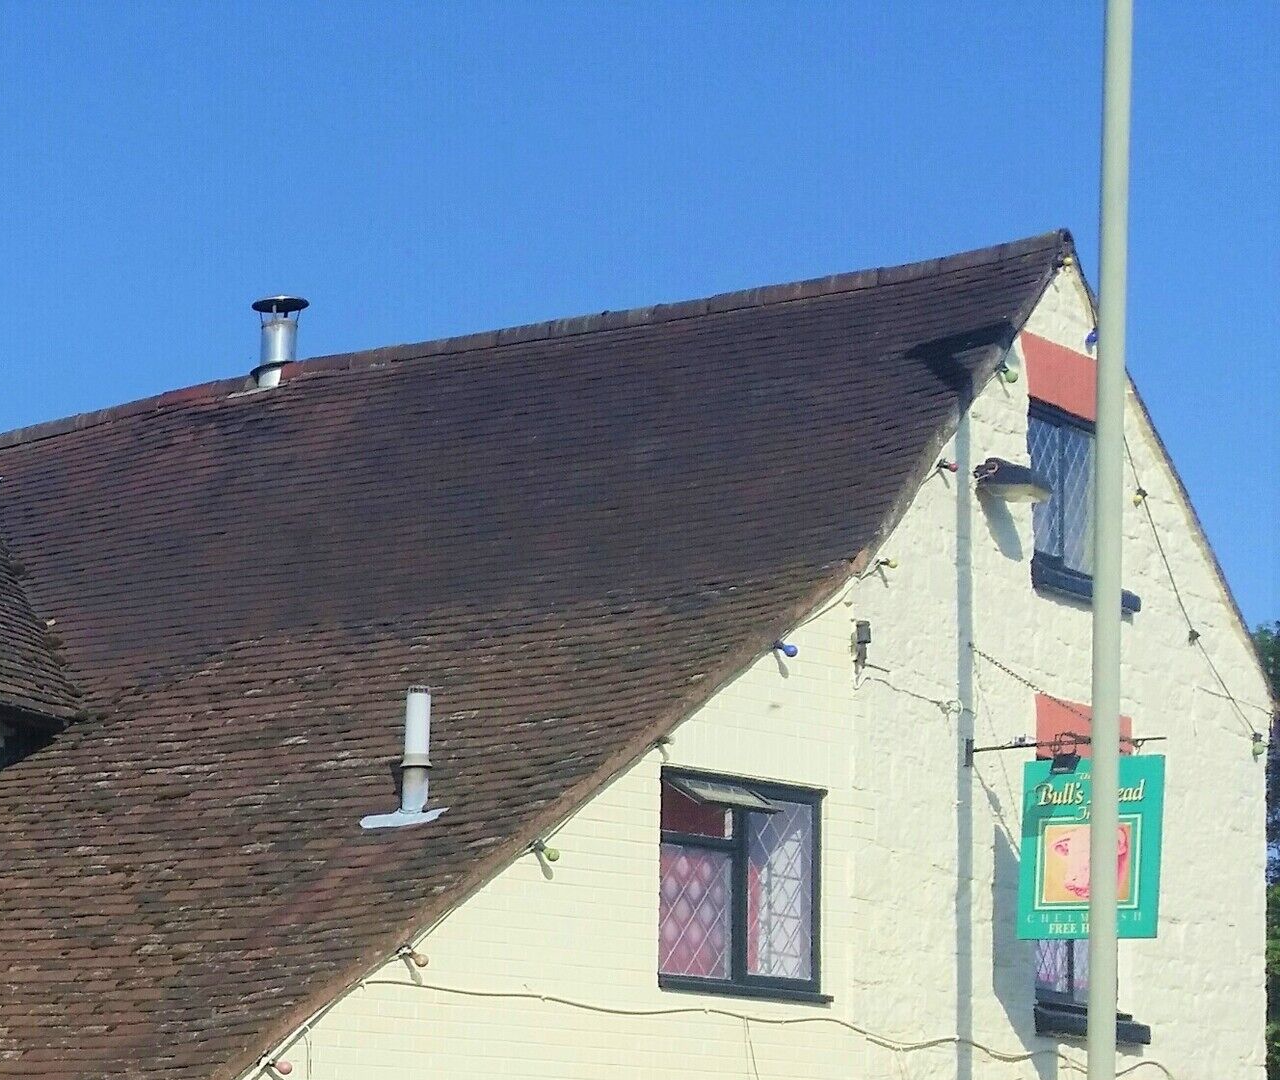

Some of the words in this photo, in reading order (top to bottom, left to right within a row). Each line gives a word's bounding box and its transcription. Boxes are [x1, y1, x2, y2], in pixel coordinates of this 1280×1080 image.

[1034, 781, 1084, 806] Bull's
[1085, 778, 1146, 805] ead
[1026, 911, 1142, 924] CHELMSH
[1048, 922, 1077, 935] FREE
